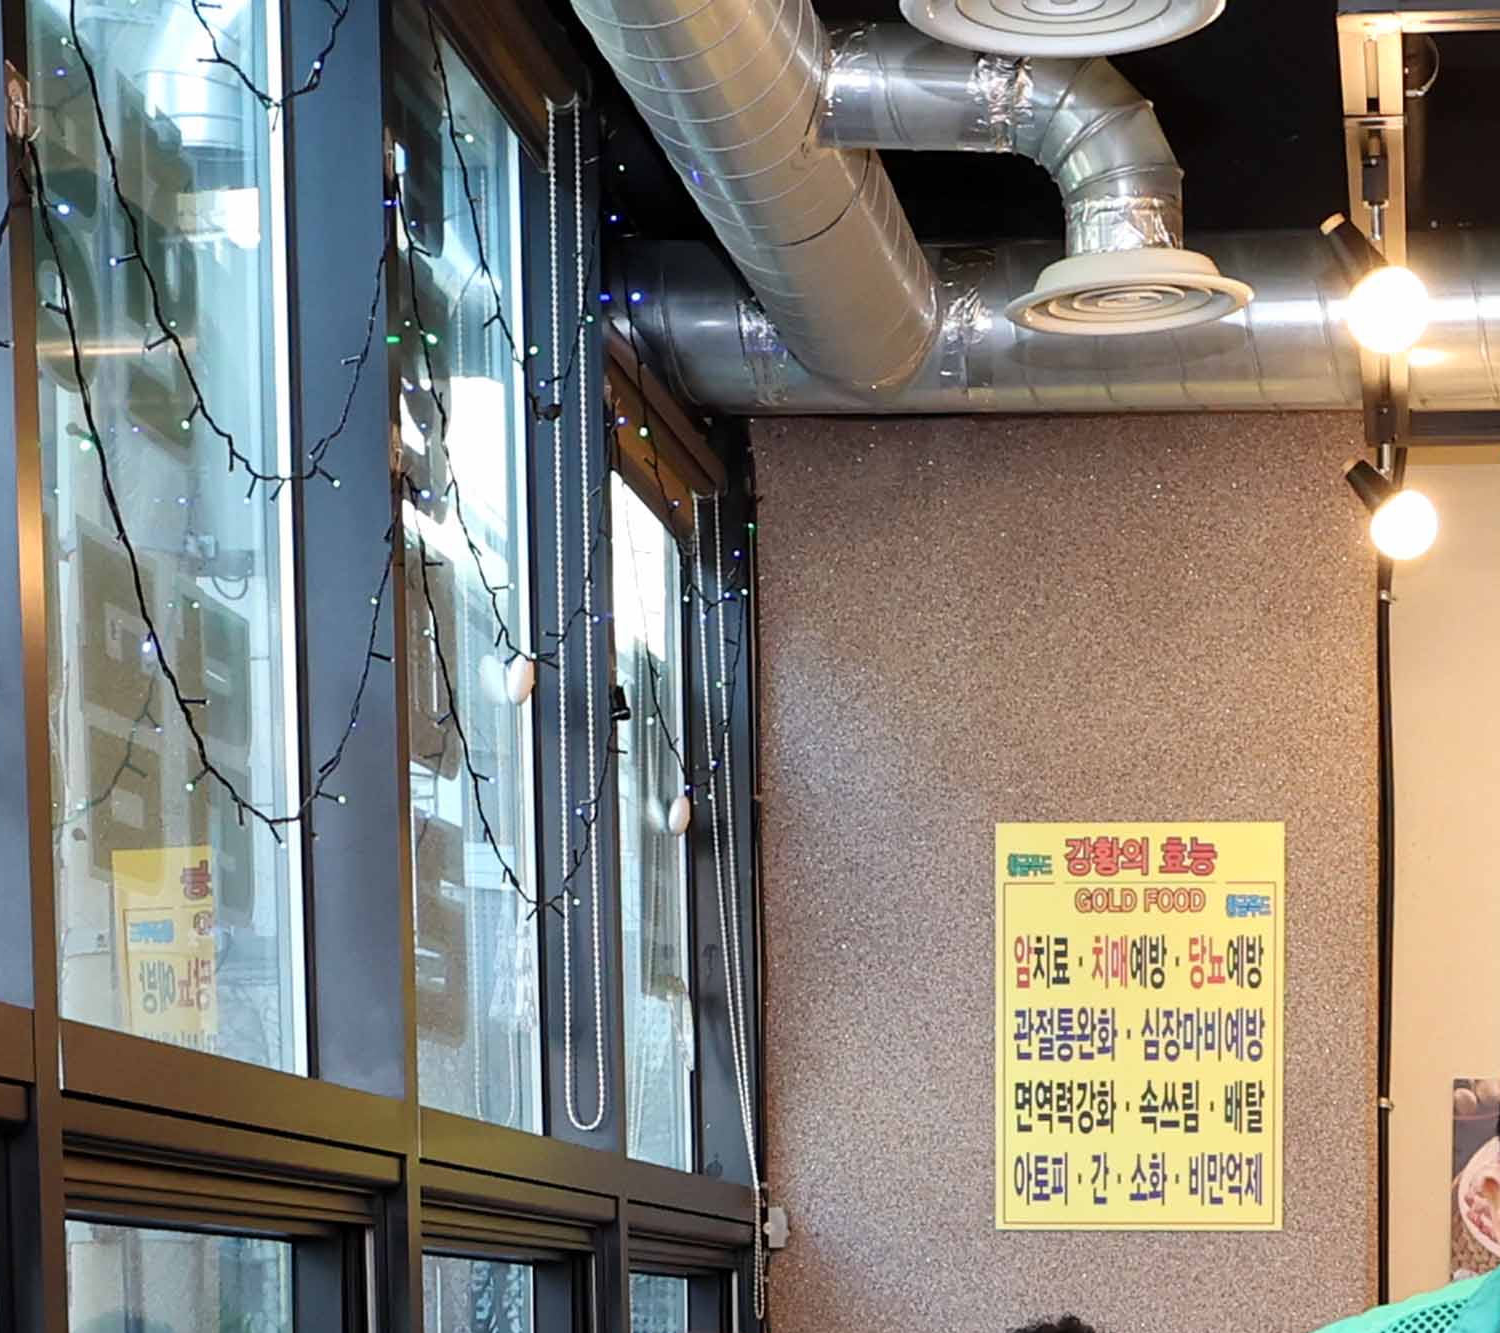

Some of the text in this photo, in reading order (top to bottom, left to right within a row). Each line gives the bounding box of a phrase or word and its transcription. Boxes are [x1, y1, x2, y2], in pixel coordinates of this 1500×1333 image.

[1065, 837, 1218, 876] 강황의 효능
[1075, 888, 1206, 914] GOLD FOOD
[1014, 935, 1264, 989] 암치료 치매예방 당뇨예방
[1013, 1007, 1265, 1062] 관절통완화 심장마비예방
[1014, 1080, 1265, 1134] 면역력강화 속쓰림 배탈
[1014, 1152, 1263, 1206] 아토피 간 소화 비만억제
